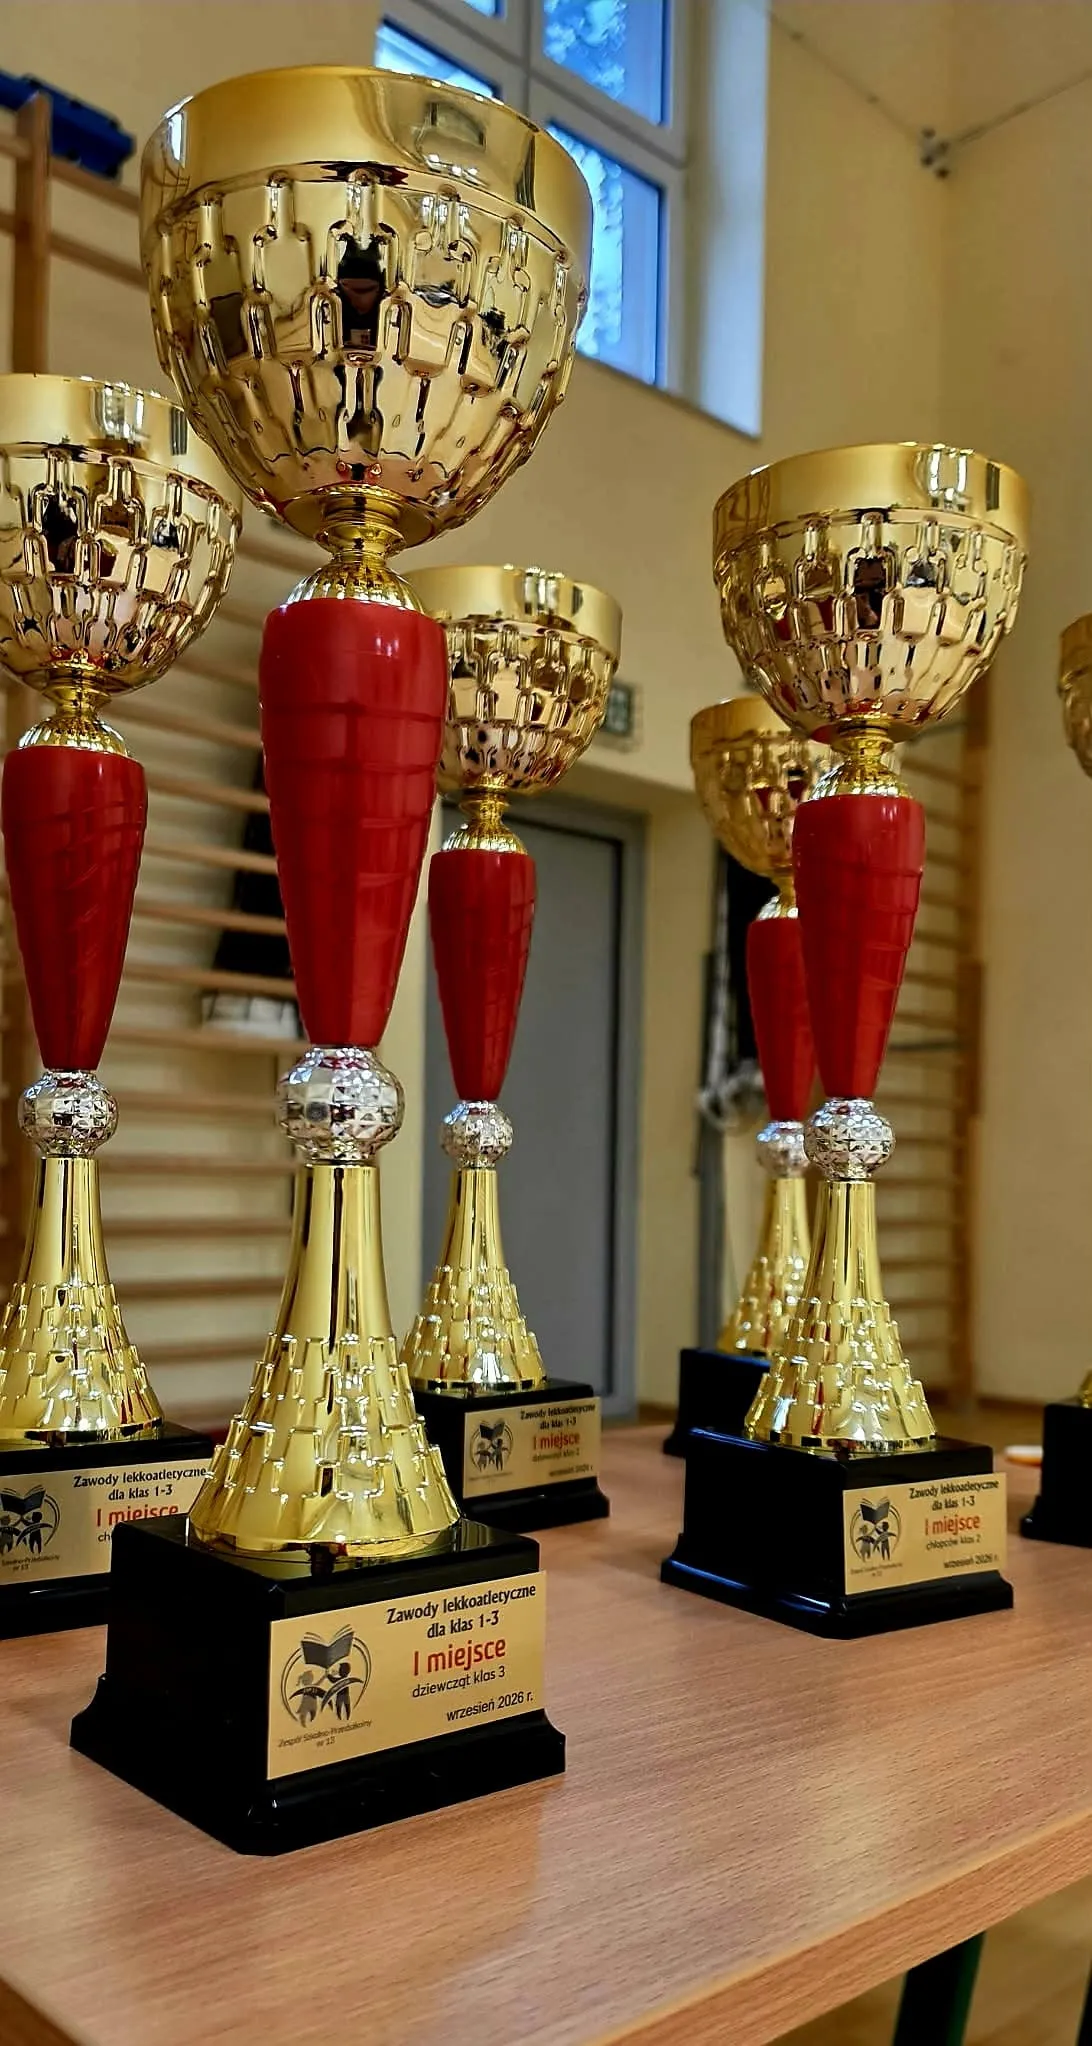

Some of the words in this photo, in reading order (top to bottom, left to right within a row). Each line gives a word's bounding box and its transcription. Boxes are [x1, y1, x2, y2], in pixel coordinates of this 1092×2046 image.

[533, 1436, 537, 1450] I
[540, 1432, 580, 1449] miejsce
[73, 1474, 119, 1488] Zawody
[123, 1468, 207, 1484] lekkoatletyczne
[108, 1489, 125, 1501] dla
[129, 1488, 149, 1499] klas
[154, 1484, 173, 1497] 1-3
[909, 1485, 939, 1499] Zawody
[932, 1500, 942, 1511] dla
[944, 1499, 959, 1509] klas
[961, 1495, 975, 1507] 1-3
[97, 1508, 102, 1527] I
[925, 1519, 929, 1536] I
[932, 1514, 980, 1535] miejsce
[386, 1601, 438, 1624] Zawody
[443, 1585, 536, 1613] lekkoatletyczne
[427, 1622, 446, 1638] dla
[450, 1618, 473, 1634] klas
[479, 1609, 499, 1628] 1-3
[413, 1650, 419, 1676] I
[427, 1639, 506, 1673] miejsce
[412, 1674, 470, 1698] dziewcząt
[473, 1669, 496, 1685] klas
[498, 1665, 505, 1678] 3
[446, 1698, 495, 1722] wrzesień
[497, 1691, 524, 1709] 2026
[526, 1691, 533, 1702] r.
